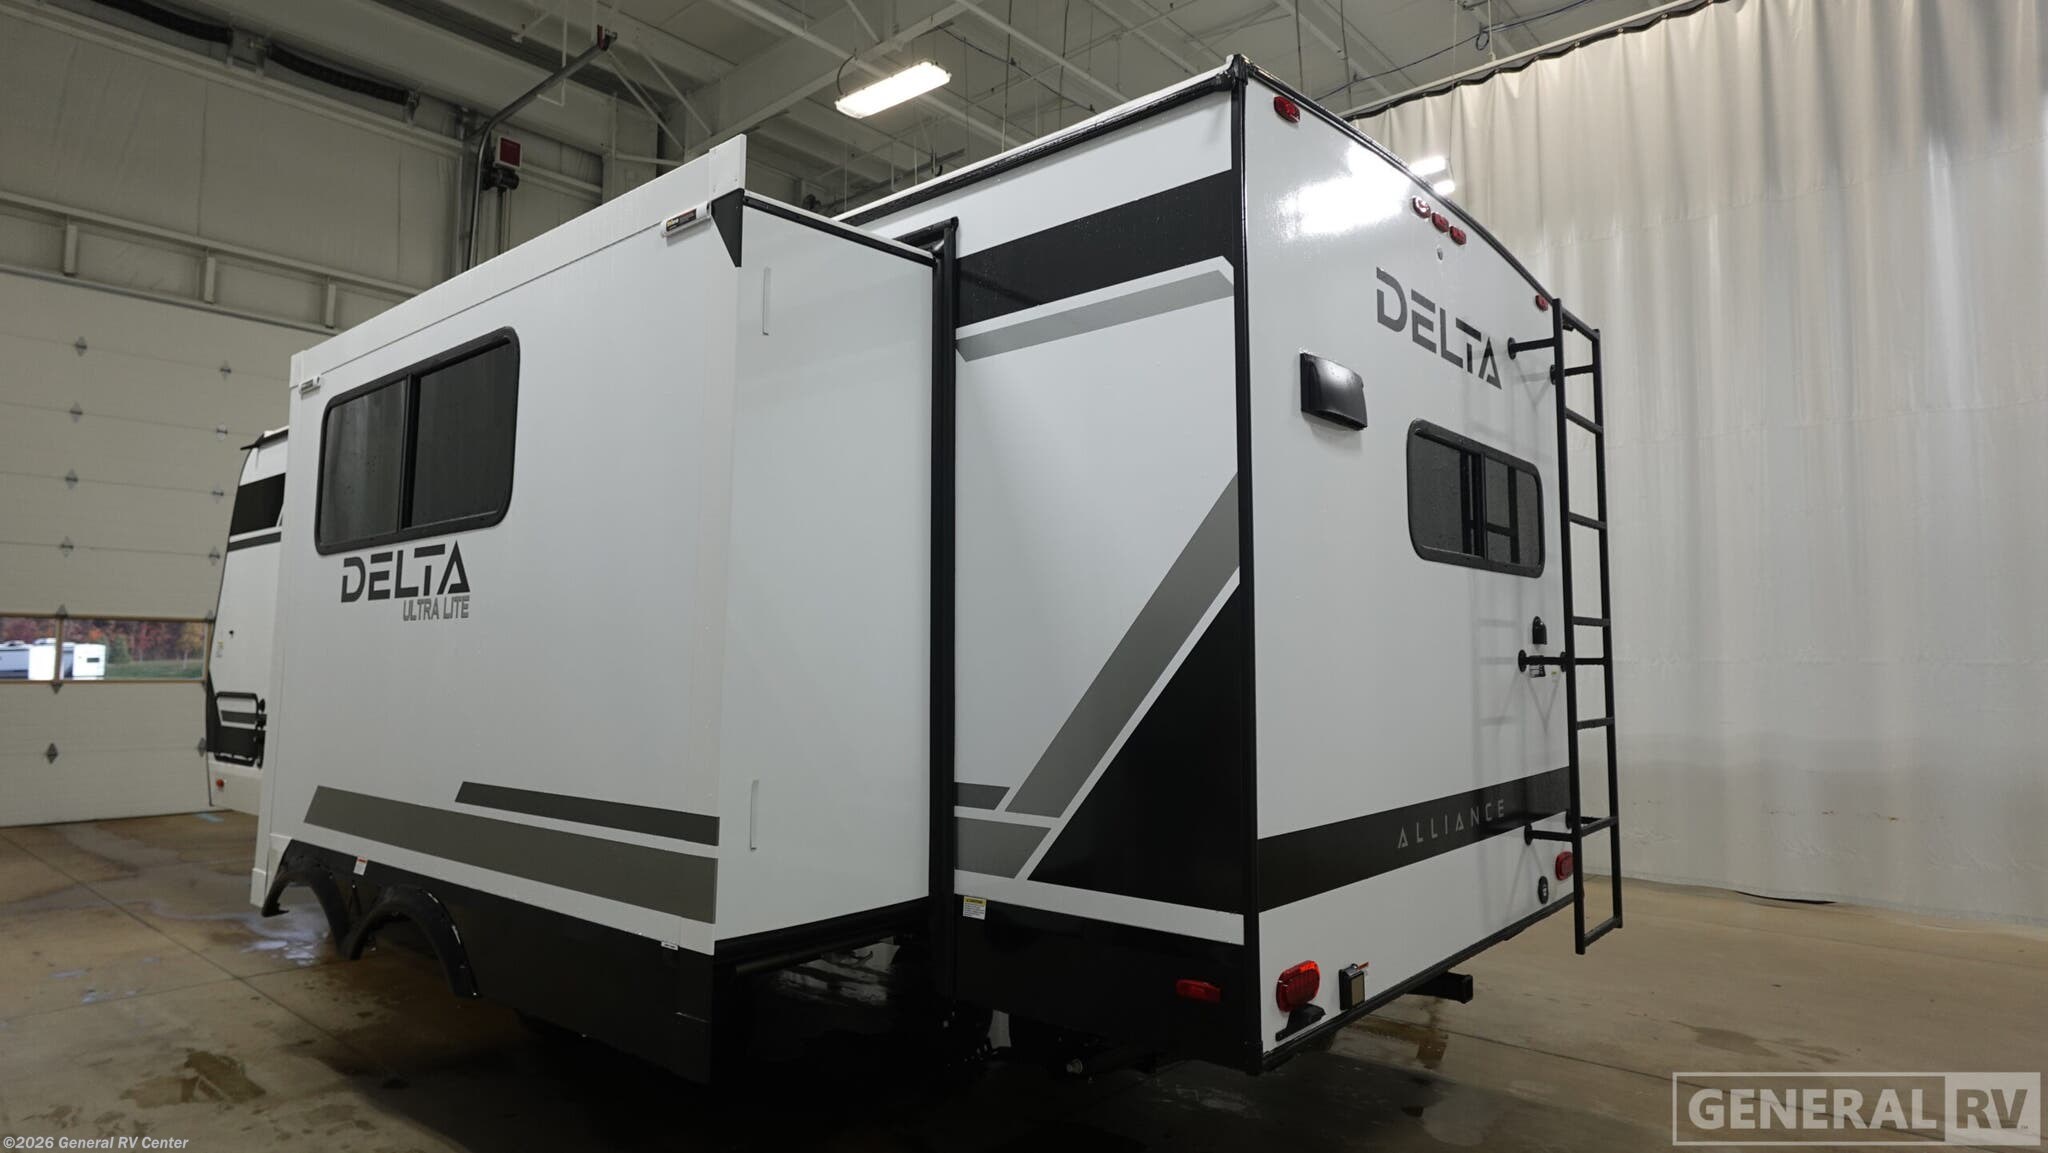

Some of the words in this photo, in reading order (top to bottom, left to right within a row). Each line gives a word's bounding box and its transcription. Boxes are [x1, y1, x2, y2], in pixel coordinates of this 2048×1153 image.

[1376, 266, 1502, 390] DELTA
[341, 540, 470, 603] DELTA
[403, 597, 440, 621] ULTRA
[443, 595, 470, 619] LITE
[1397, 799, 1505, 849] ALLIANCE
